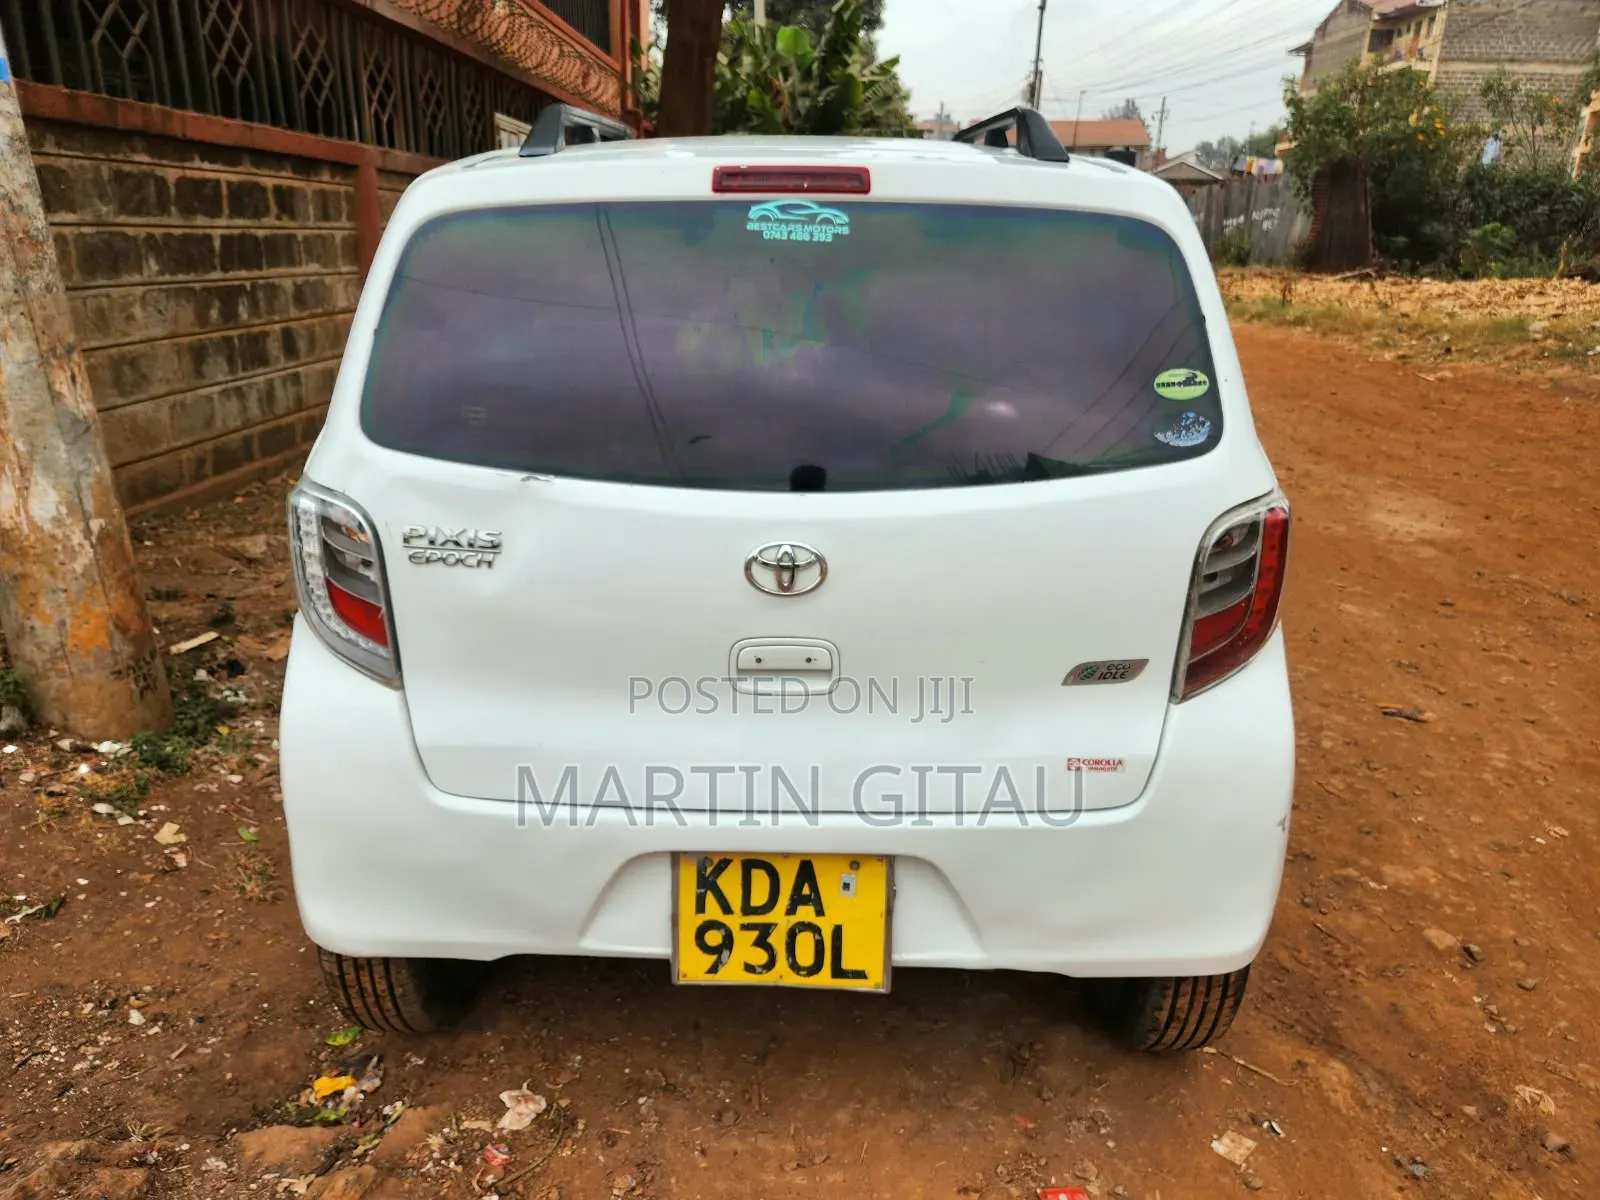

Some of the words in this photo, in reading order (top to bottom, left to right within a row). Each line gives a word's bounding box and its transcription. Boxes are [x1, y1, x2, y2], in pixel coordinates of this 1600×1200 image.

[402, 526, 502, 549] PIXIS
[1098, 671, 1128, 681] IDLE
[1081, 759, 1123, 767] COROLLA
[695, 858, 826, 917] KDA
[694, 919, 869, 980] 930L
